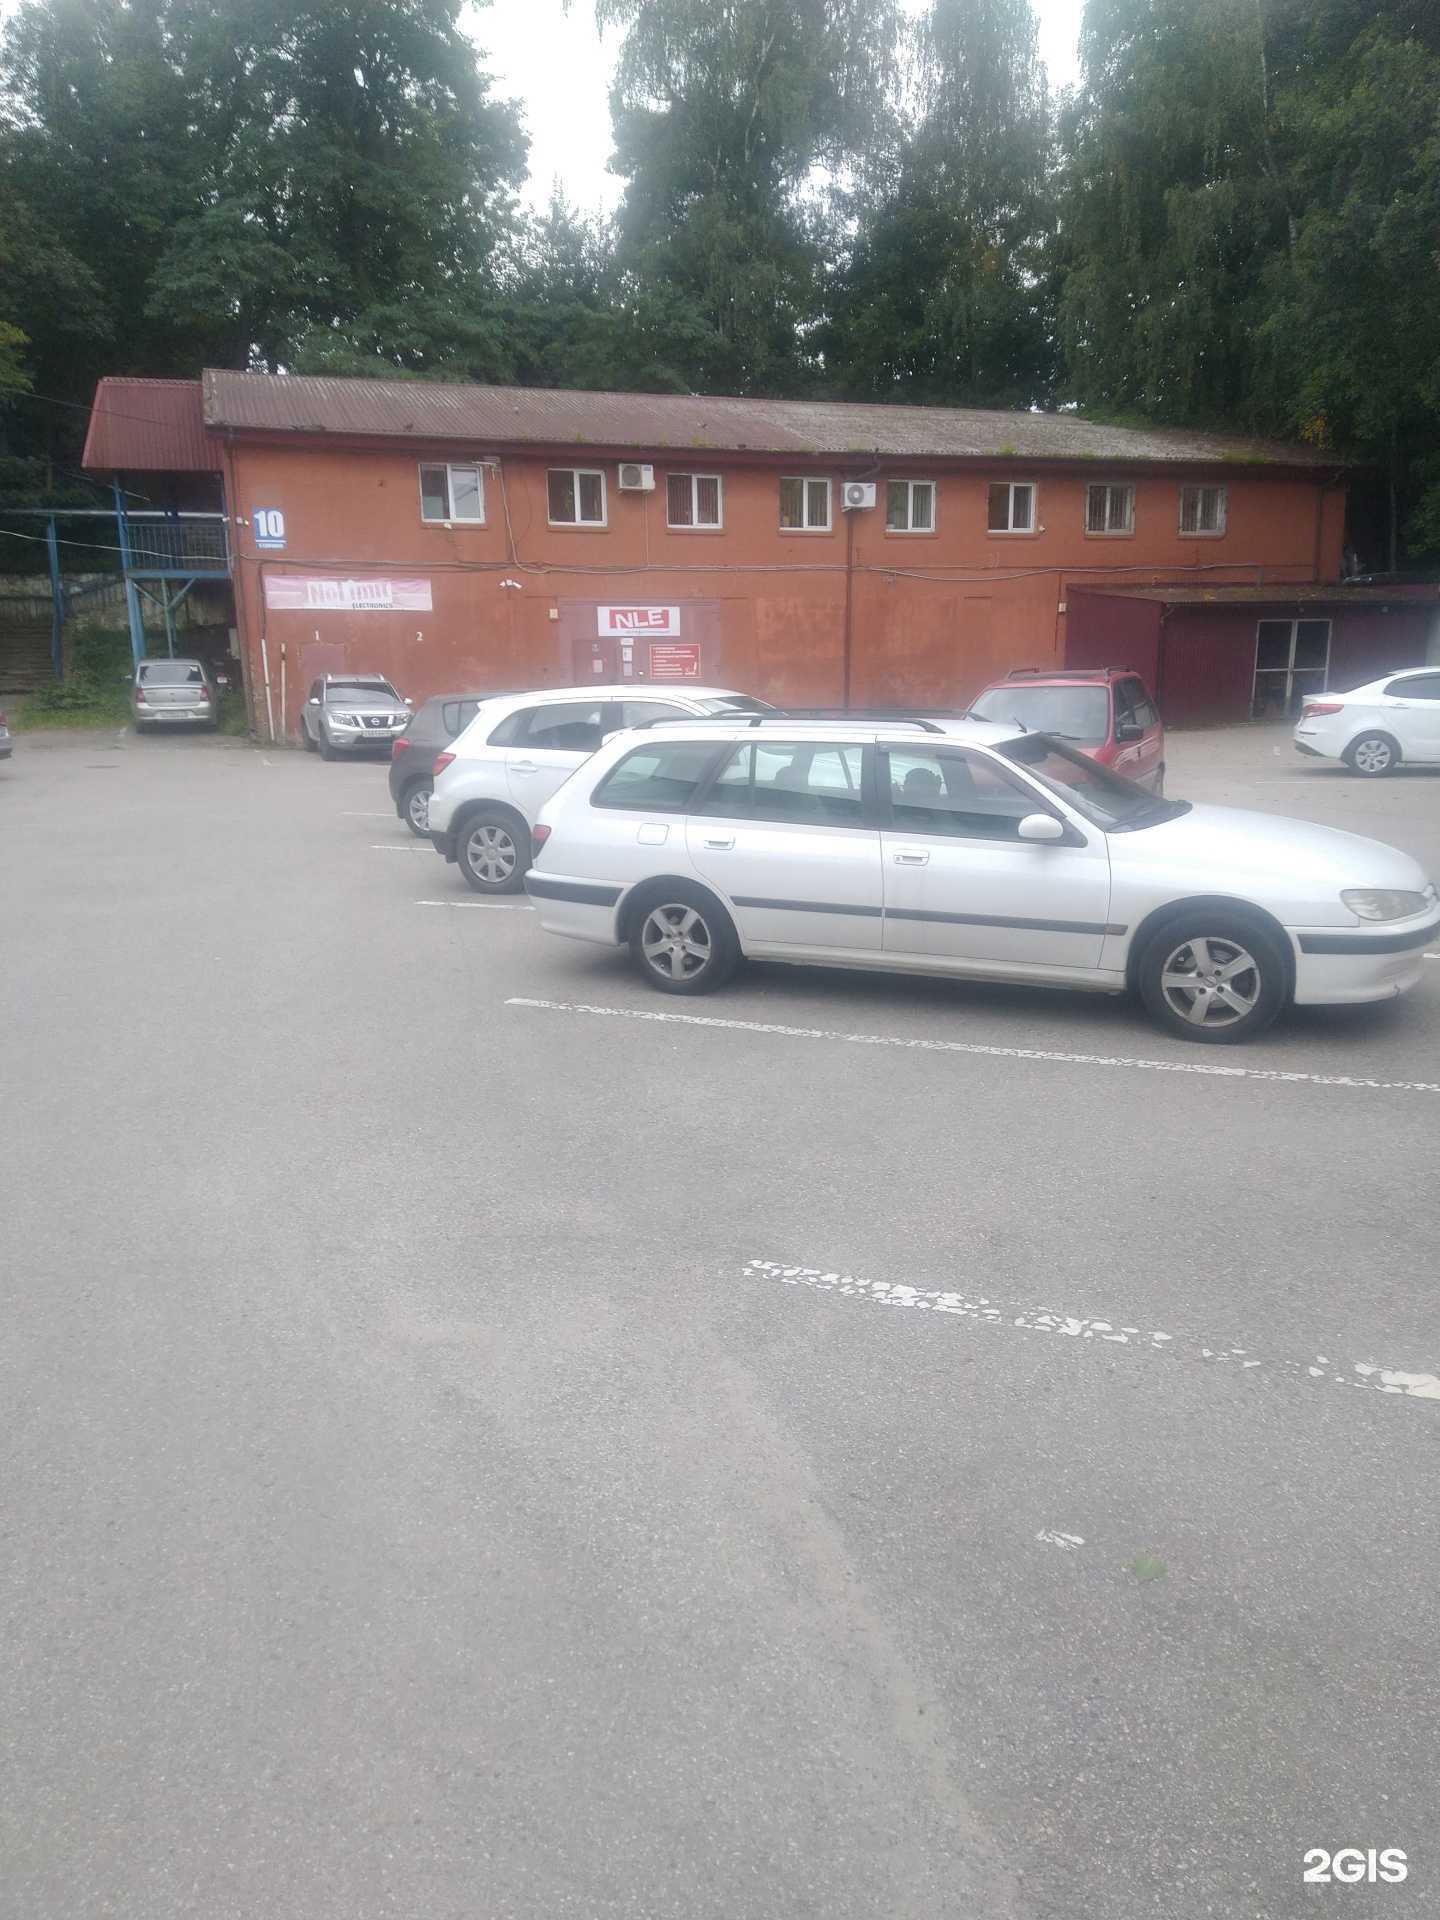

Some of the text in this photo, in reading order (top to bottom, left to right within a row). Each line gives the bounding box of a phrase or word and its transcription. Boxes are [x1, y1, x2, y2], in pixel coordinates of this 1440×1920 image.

[254, 510, 284, 537] 10
[352, 602, 393, 610] ELECTRONICS
[615, 609, 665, 630] NLE
[314, 630, 320, 641] 1
[415, 631, 423, 641] 2
